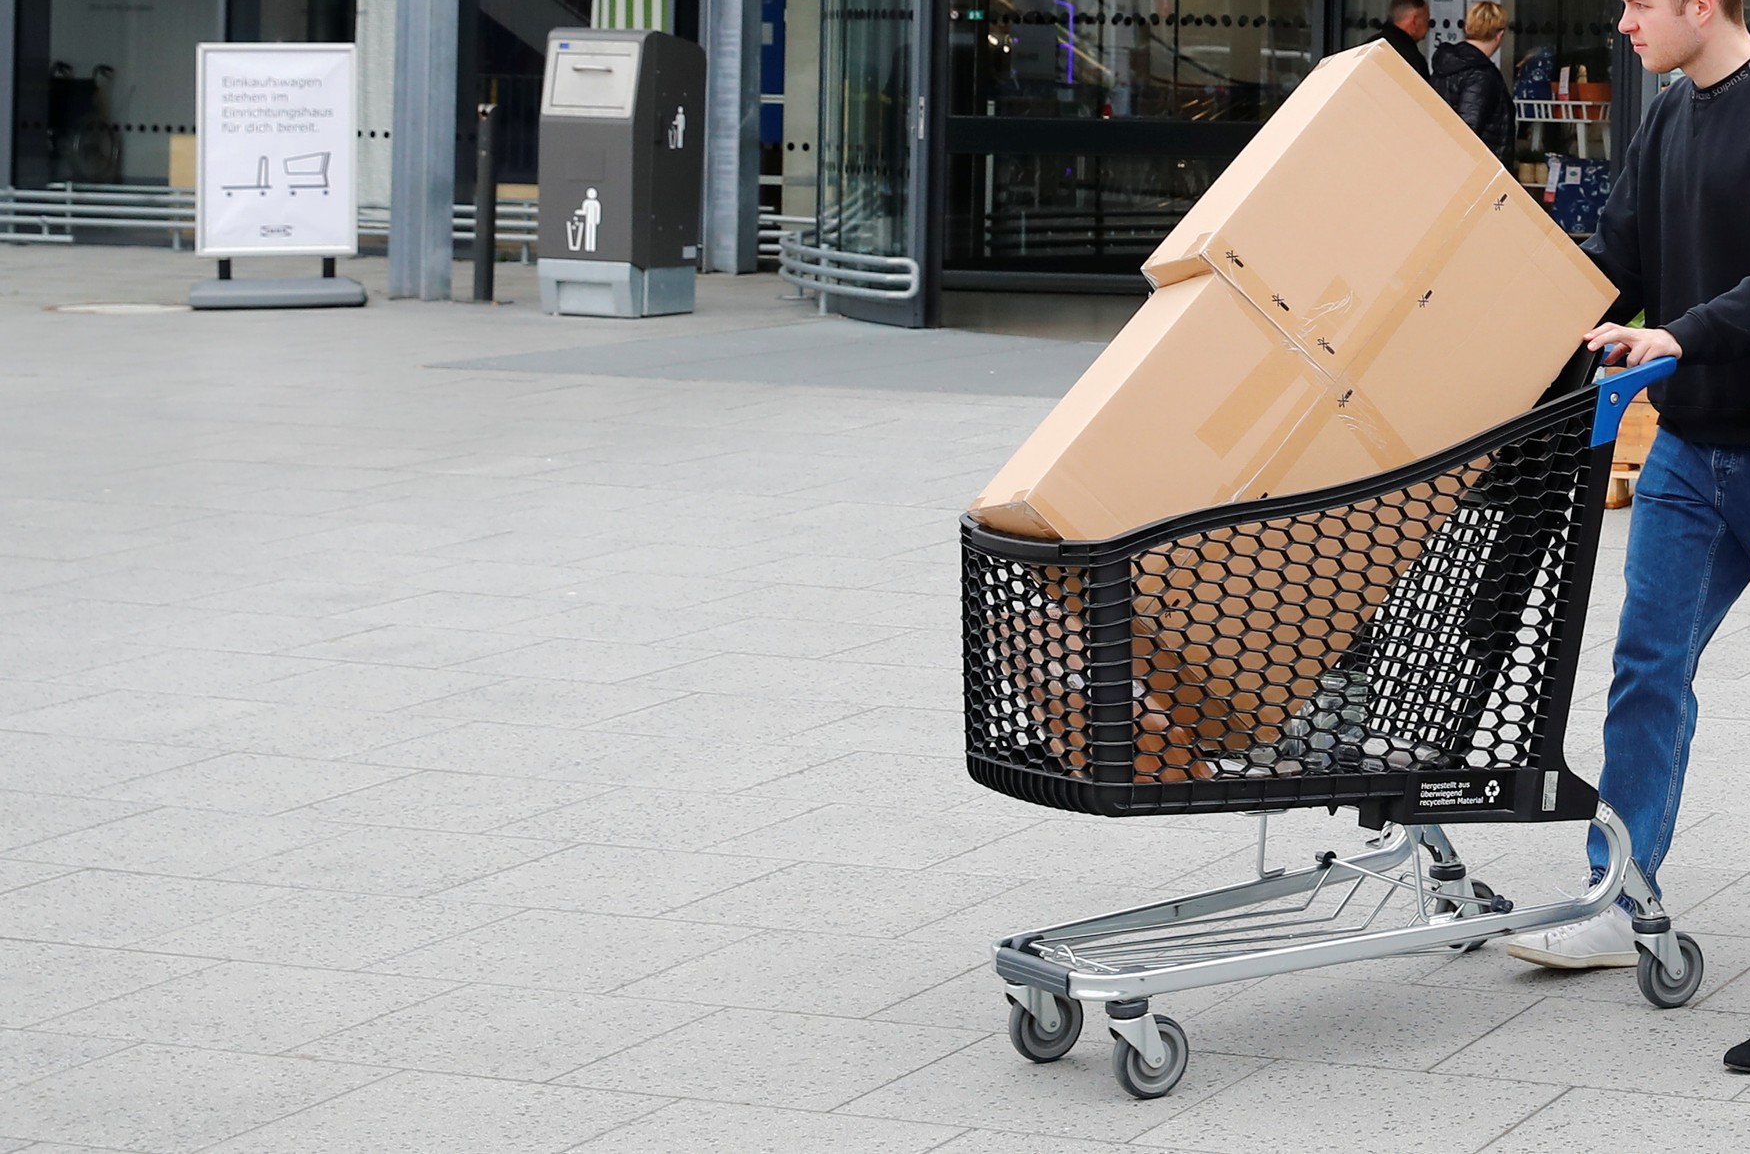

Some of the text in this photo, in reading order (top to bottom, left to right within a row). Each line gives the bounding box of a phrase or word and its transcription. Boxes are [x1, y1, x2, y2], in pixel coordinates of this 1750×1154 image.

[221, 76, 323, 88] Einkaufswagen
[271, 92, 289, 102] im
[221, 107, 334, 119] Einrichtungshaus
[221, 122, 241, 133] für
[245, 122, 273, 133] dich
[1420, 790, 1462, 798] überwiegend
[1419, 797, 1484, 807] recyceltem Material
